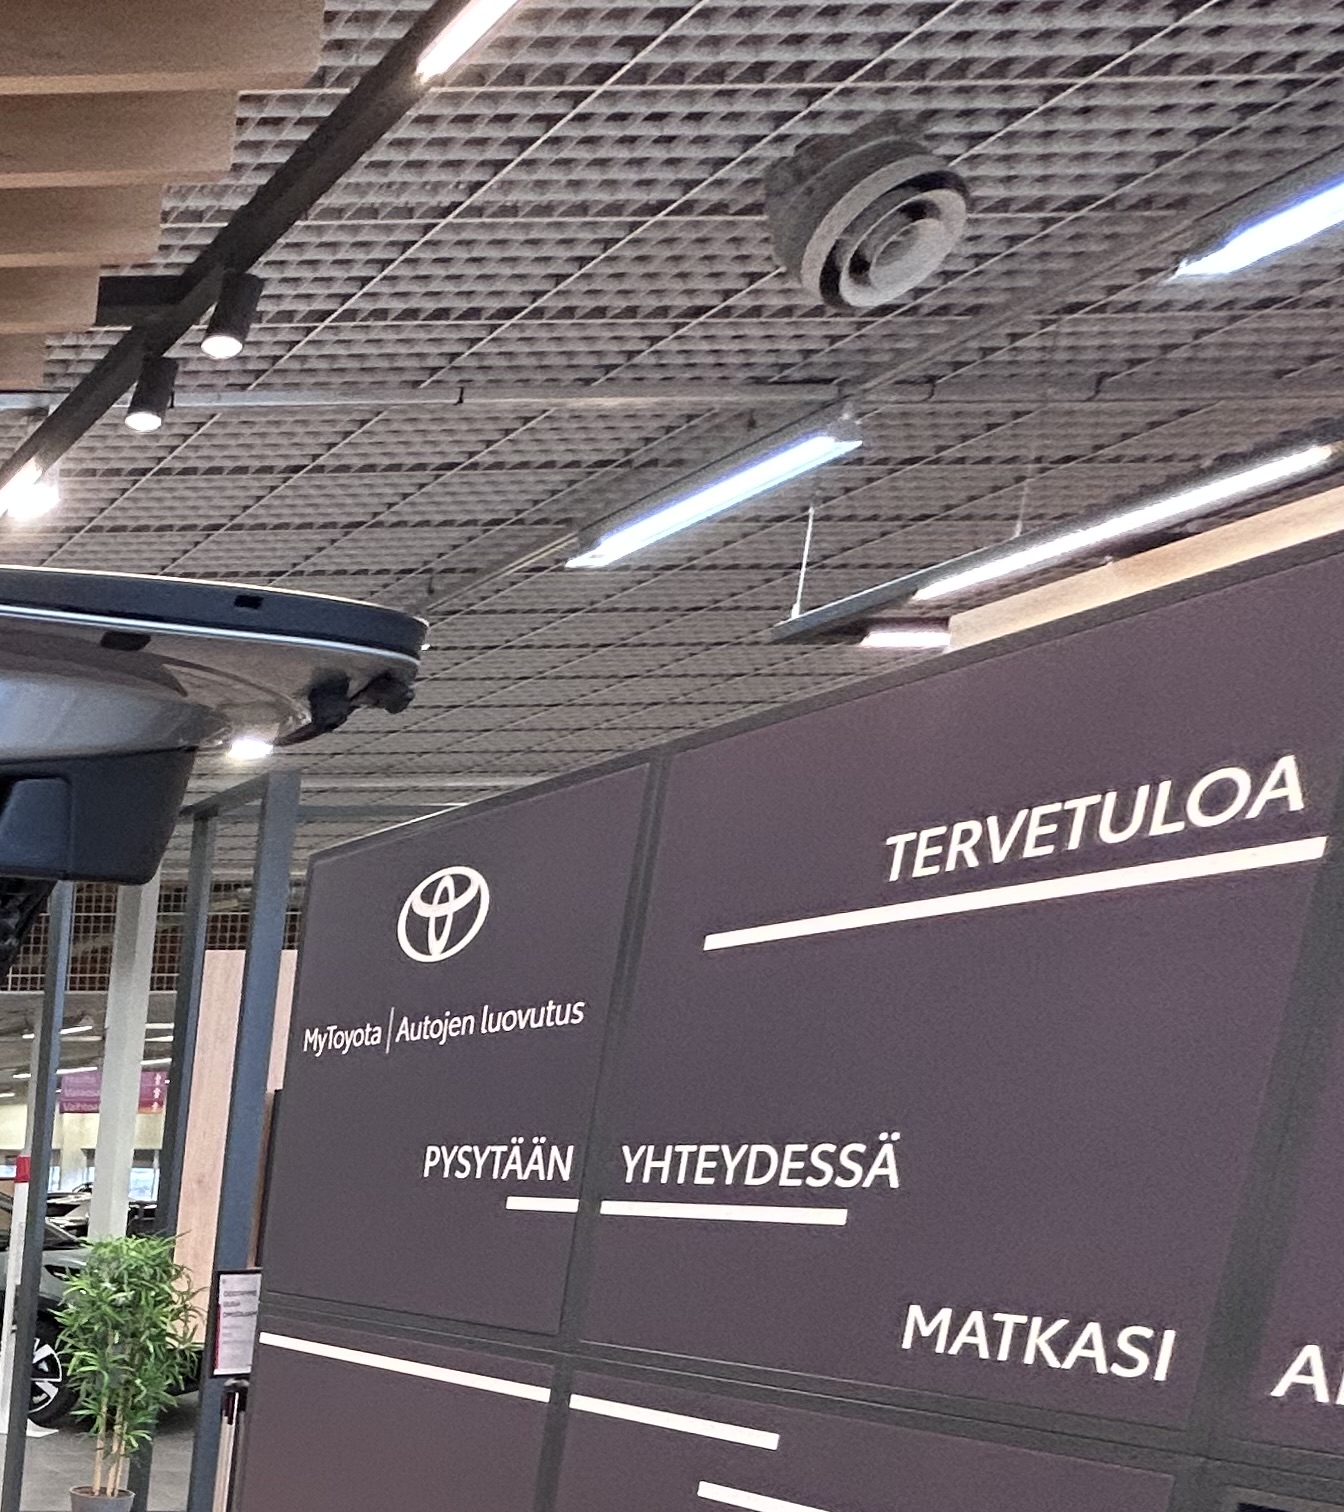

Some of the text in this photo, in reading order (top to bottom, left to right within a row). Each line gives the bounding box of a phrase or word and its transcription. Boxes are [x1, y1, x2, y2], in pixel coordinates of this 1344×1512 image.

[885, 754, 1305, 882] TERVETULOA
[303, 1000, 586, 1057] MyToyota Autojen luovutus
[422, 1131, 902, 1189] PYSYTÄÄN YHTEYDESSÄ
[901, 1304, 1176, 1381] MATKASI
[1269, 1344, 1344, 1406] A
